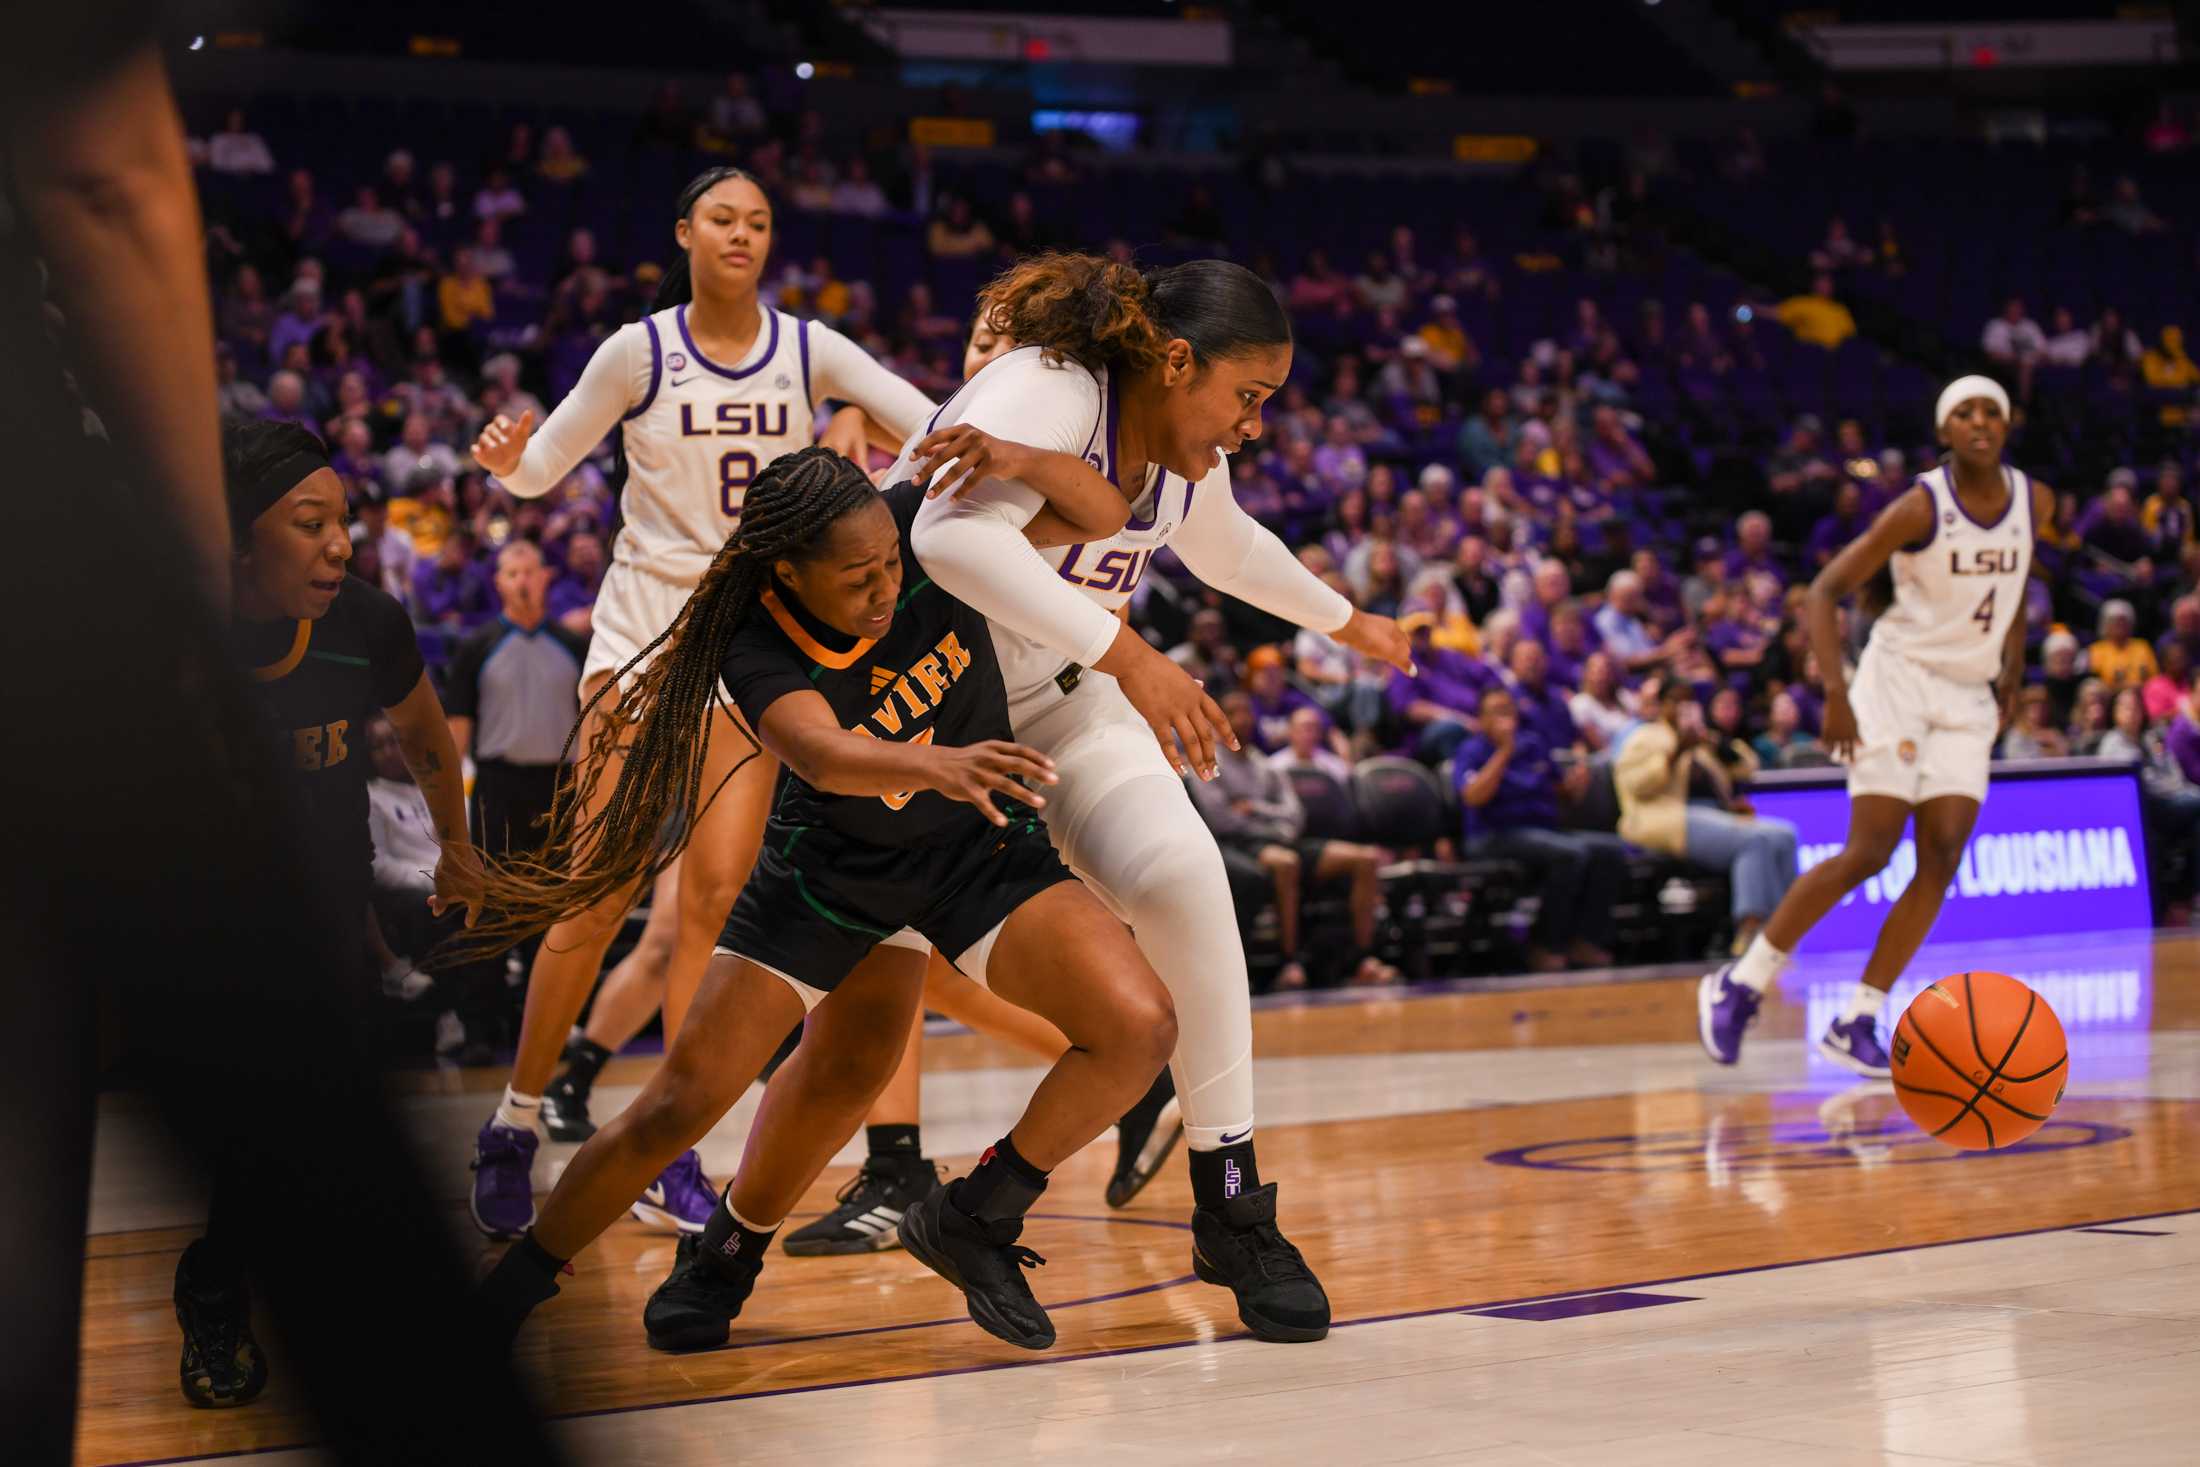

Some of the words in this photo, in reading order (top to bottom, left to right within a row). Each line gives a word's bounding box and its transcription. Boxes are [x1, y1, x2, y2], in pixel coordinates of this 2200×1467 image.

[680, 402, 789, 438] LSU
[719, 450, 758, 519] 8
[1056, 543, 1153, 594] LSU
[1949, 549, 2018, 576] LSU
[1971, 584, 1998, 634] 4
[850, 631, 971, 742] VIER
[1958, 826, 2138, 898] LOUISIANA
